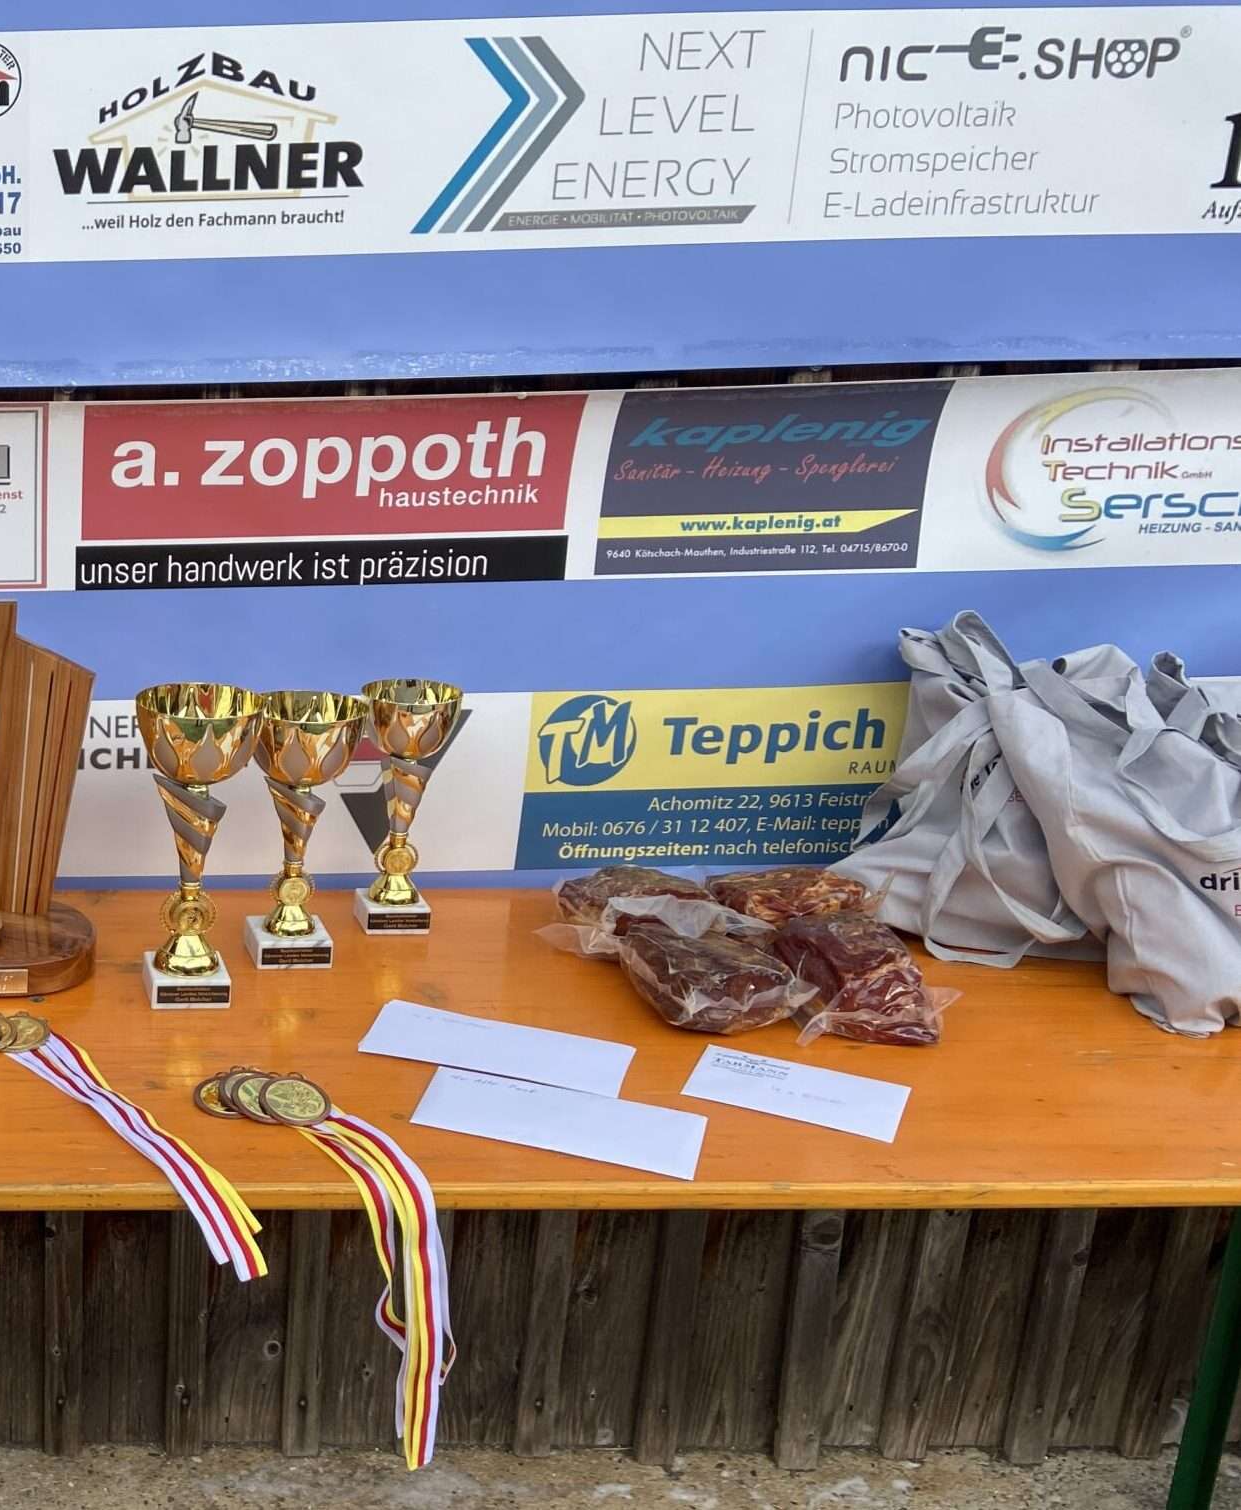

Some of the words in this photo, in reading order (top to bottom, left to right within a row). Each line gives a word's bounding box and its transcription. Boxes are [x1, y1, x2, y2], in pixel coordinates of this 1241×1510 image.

[639, 30, 766, 71] NEXT
[98, 51, 317, 124] HOLZBAU
[599, 94, 756, 136] LEVEL
[834, 101, 1016, 130] Photovoltaik
[53, 141, 364, 195] WALLNER
[829, 146, 1038, 177] Stromspeicher
[551, 157, 751, 201] ENERGY
[508, 215, 559, 227] ENERGIE
[644, 208, 739, 222] PHOTOVOLTAIK
[824, 189, 1100, 219] E-Ladeinfrastruktur
[1201, 199, 1241, 224] Auf
[82, 215, 125, 230] ...weil
[129, 214, 160, 229] Holz
[166, 213, 194, 228] den
[198, 212, 277, 227] Fachmann
[280, 209, 344, 225] braucht!
[629, 410, 932, 453] kaplenig
[110, 439, 180, 488] a.
[200, 416, 548, 500] zoppoth
[614, 458, 681, 481] Sanitär
[702, 456, 770, 485] Heizung
[795, 452, 899, 484] Spenglerei
[1042, 460, 1179, 482] Technik
[1181, 470, 1213, 479] GmbH
[379, 484, 539, 508] haustechnik
[1059, 488, 1241, 523] Sersc
[680, 516, 842, 533] www.kaplenig.at
[1138, 523, 1202, 535] HEIZUNG
[606, 549, 631, 559] 9640
[729, 545, 796, 556] Industriestraße
[840, 542, 909, 554] 04715/8670-0
[80, 561, 158, 585] unser
[167, 552, 303, 584] handwerk
[313, 552, 351, 580] ist
[360, 550, 488, 586] präzision
[663, 708, 886, 765] Teppich
[648, 796, 734, 812] Achomitz
[738, 796, 765, 812] 22,
[769, 793, 813, 808] 9613
[542, 821, 598, 838] Mobil:
[602, 821, 645, 835] 0676
[663, 820, 682, 834] 31
[689, 819, 709, 833] 12
[714, 818, 750, 834] 407,
[756, 817, 817, 832] E-Mail:
[558, 843, 709, 861] Öffnungszeiten:
[714, 841, 758, 855] nach
